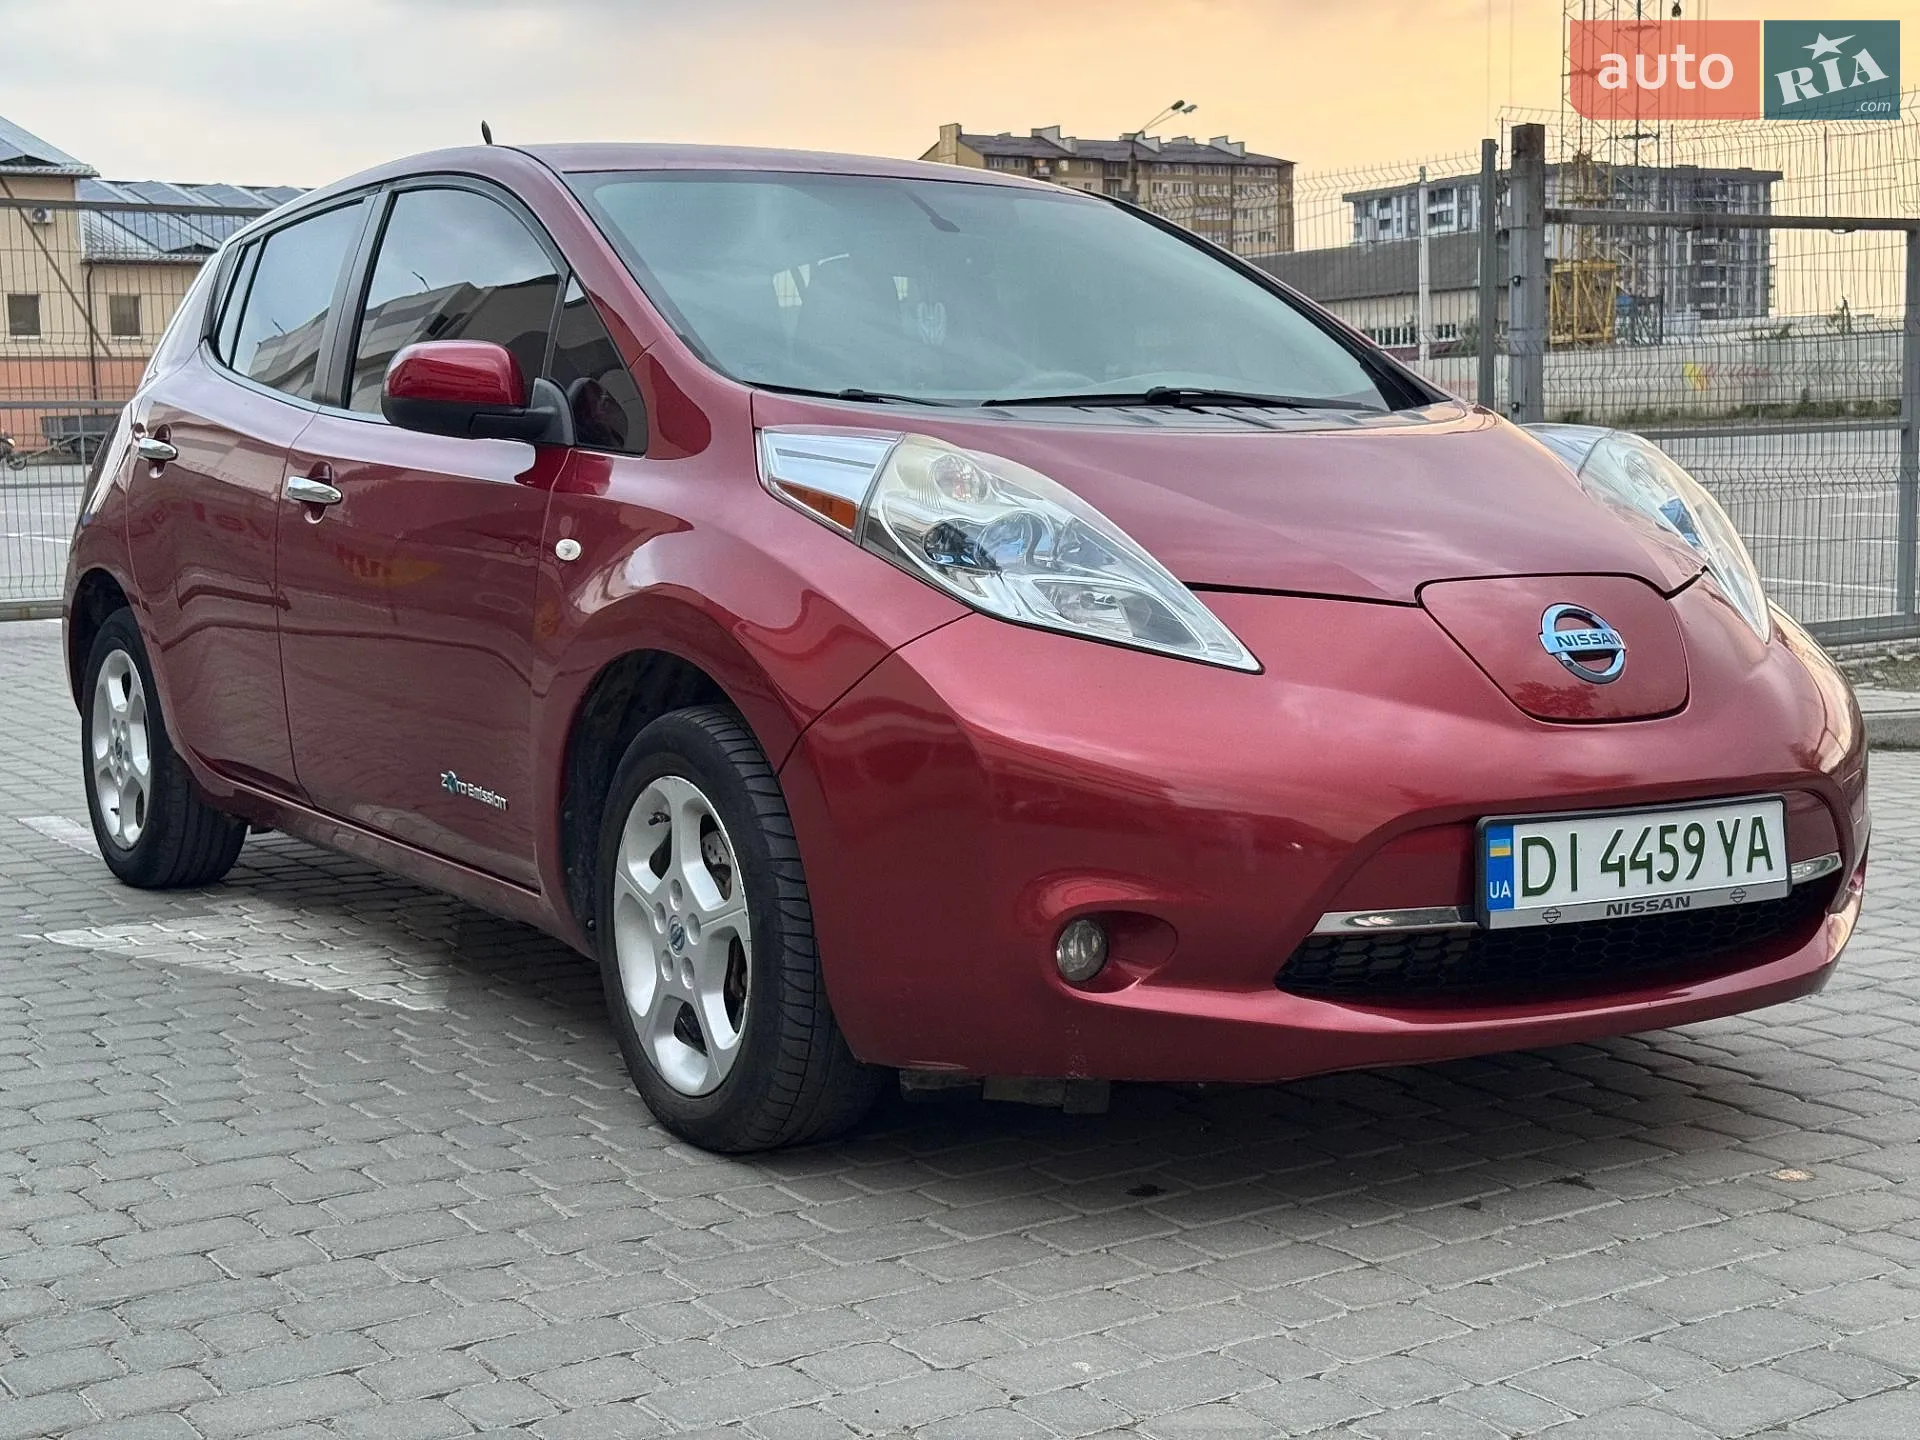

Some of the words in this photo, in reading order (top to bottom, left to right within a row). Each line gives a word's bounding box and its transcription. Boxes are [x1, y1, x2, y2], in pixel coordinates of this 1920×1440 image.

[1555, 632, 1622, 648] NISSAN
[467, 783, 507, 811] Emission
[1521, 832, 1578, 897] DI
[1600, 822, 1706, 888] 4459
[1716, 815, 1773, 877] YA
[1489, 880, 1511, 899] UA
[1606, 894, 1691, 917] NISSAN
